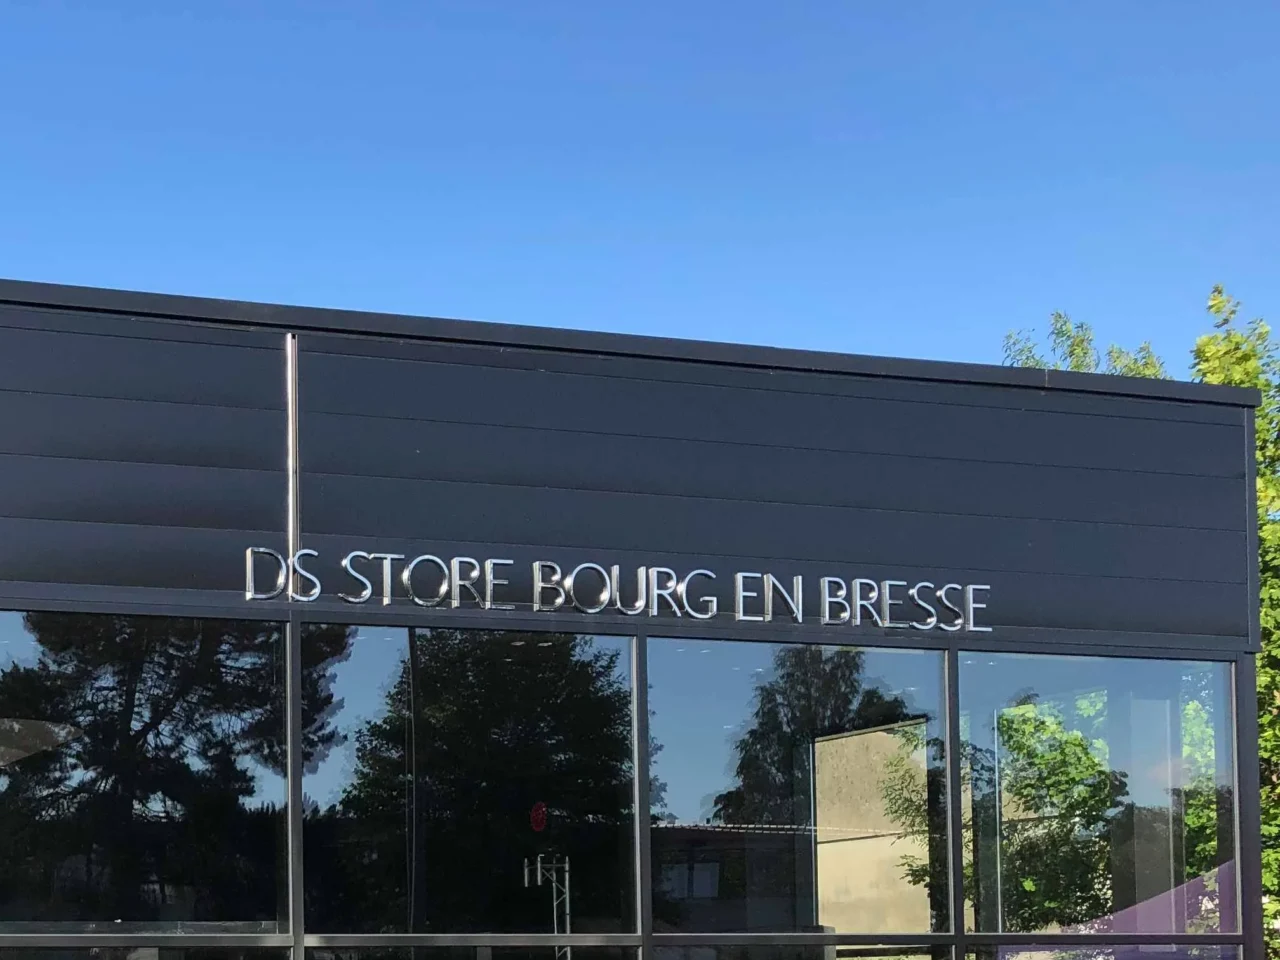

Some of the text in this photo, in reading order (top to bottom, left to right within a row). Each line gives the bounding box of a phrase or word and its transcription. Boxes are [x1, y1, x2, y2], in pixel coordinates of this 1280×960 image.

[245, 547, 994, 633] DS STORE BOURG EN BRESSE
